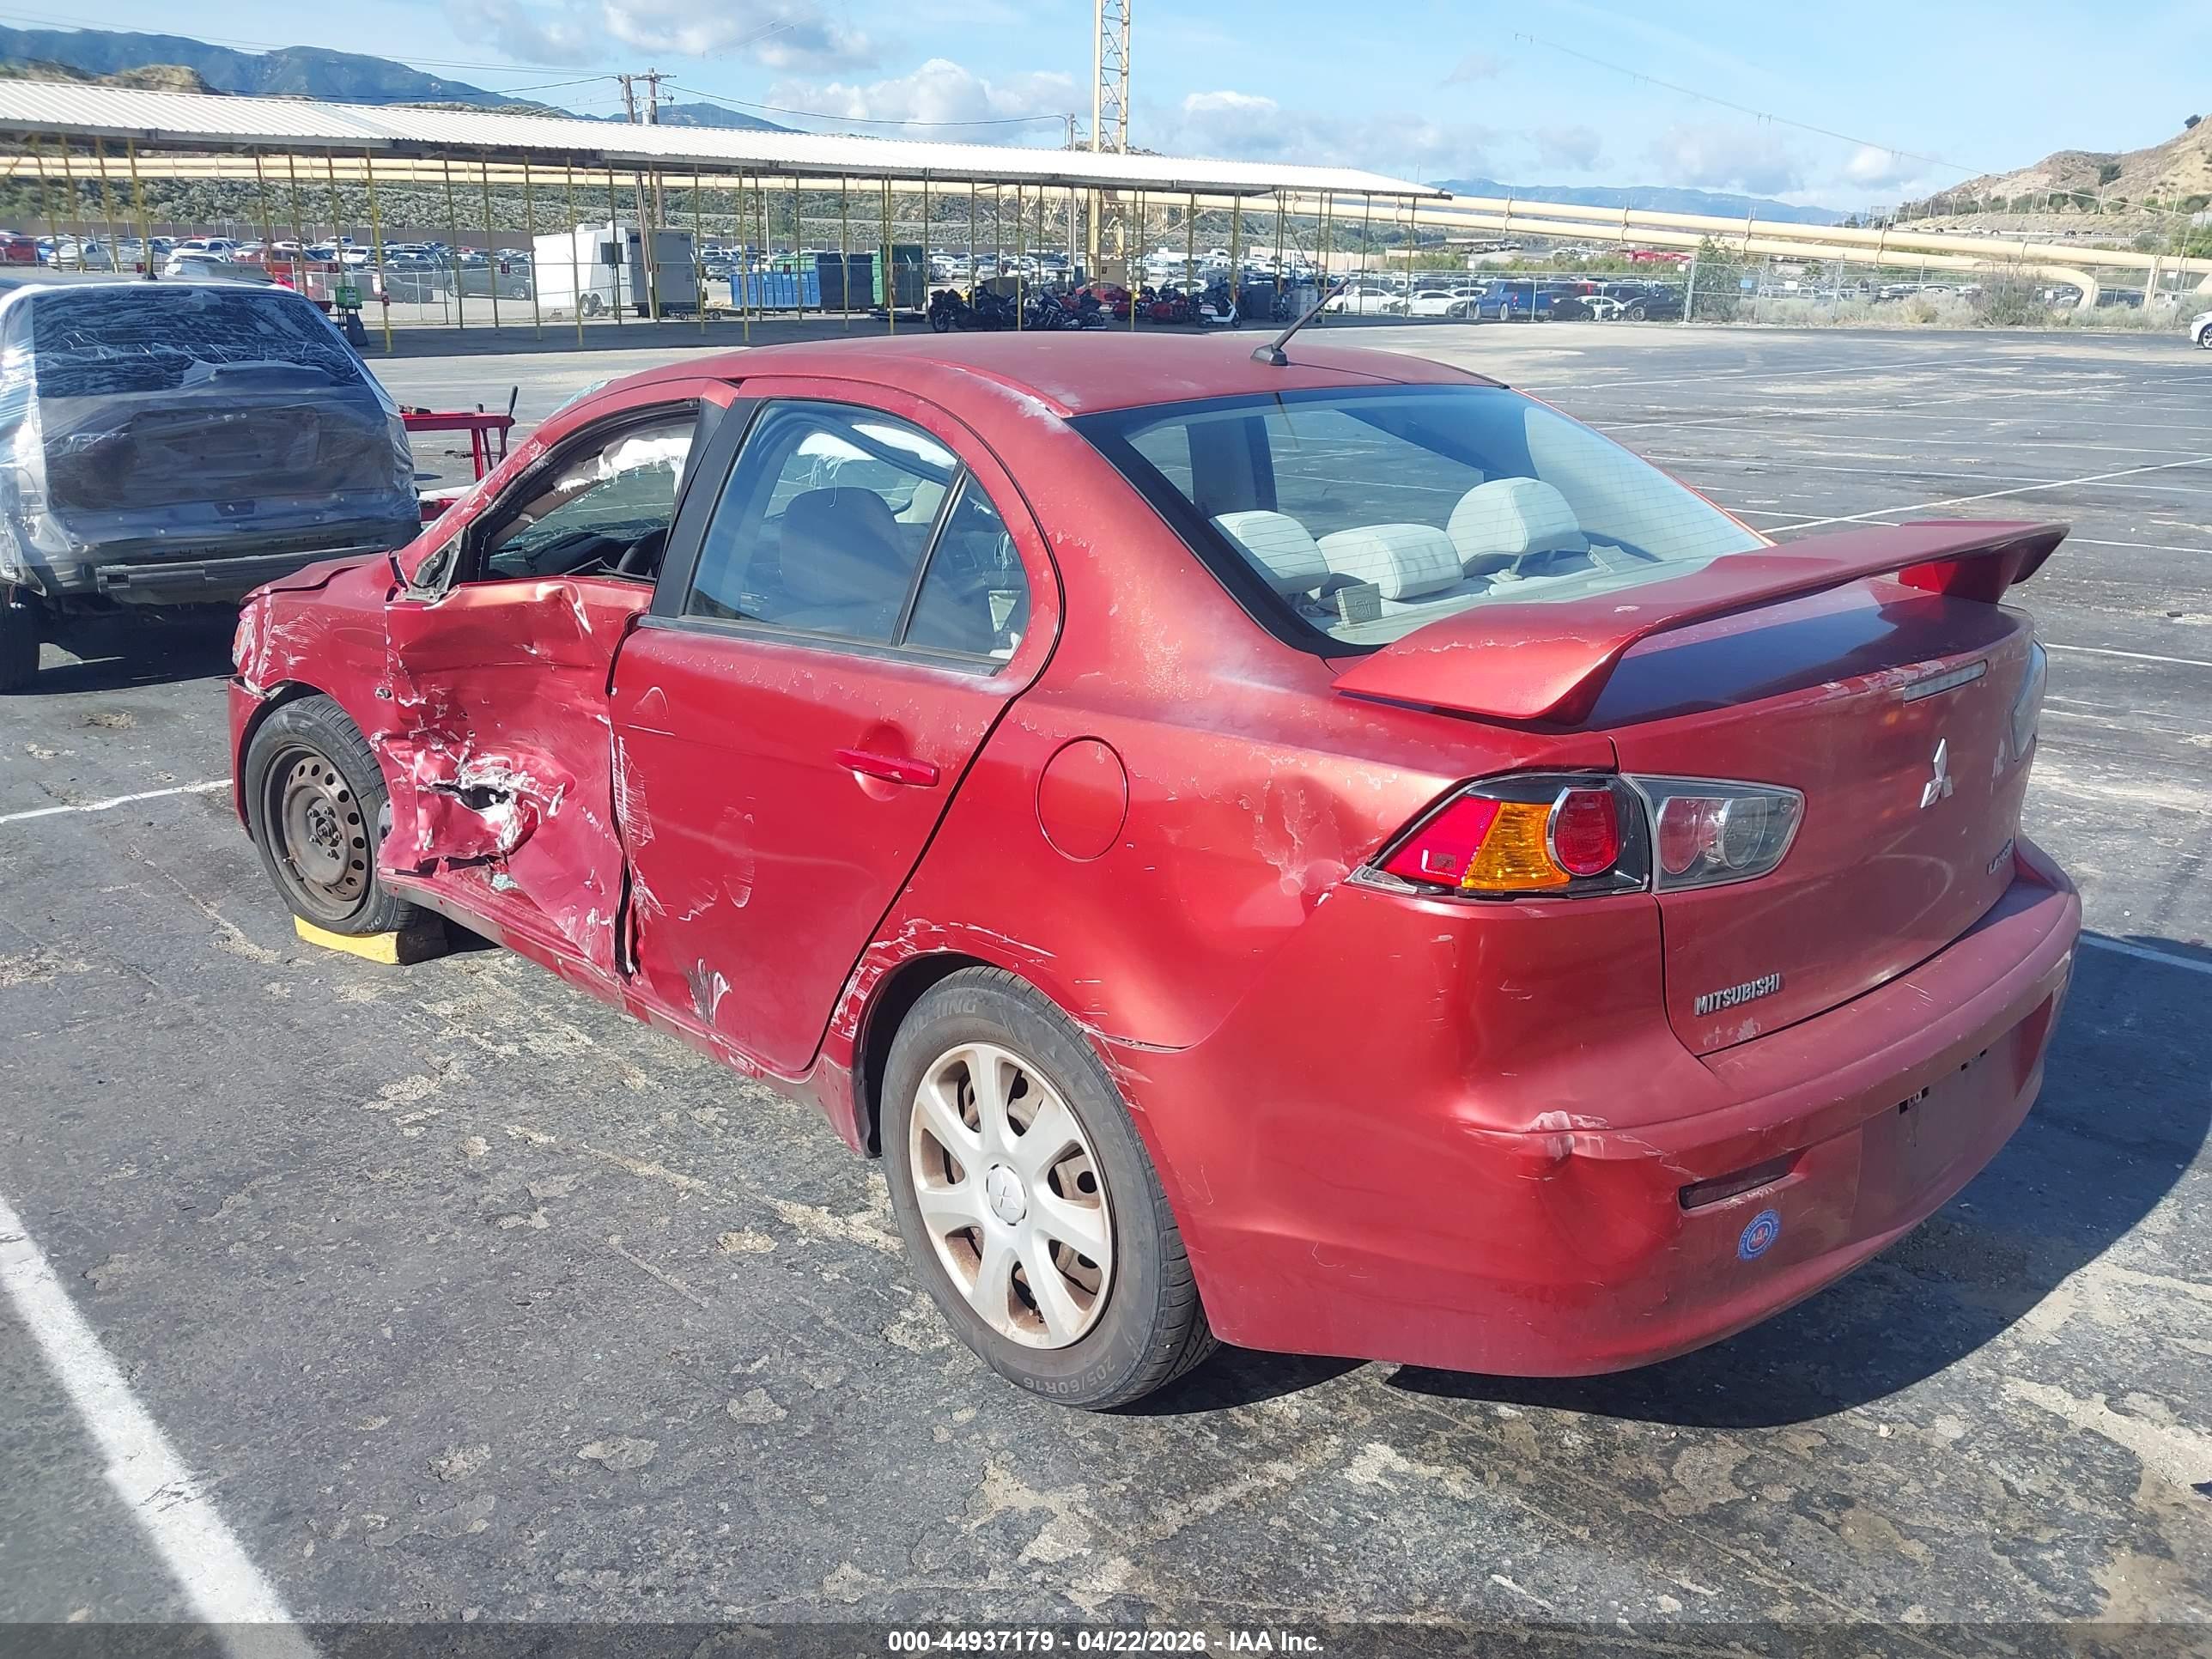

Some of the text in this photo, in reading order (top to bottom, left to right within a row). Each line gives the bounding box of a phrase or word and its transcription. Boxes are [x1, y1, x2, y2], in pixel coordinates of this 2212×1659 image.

[1694, 973, 1781, 1016] MITSUBISHI
[1749, 1227, 1769, 1244] AAA
[1023, 1355, 1116, 1395] 205/60R16
